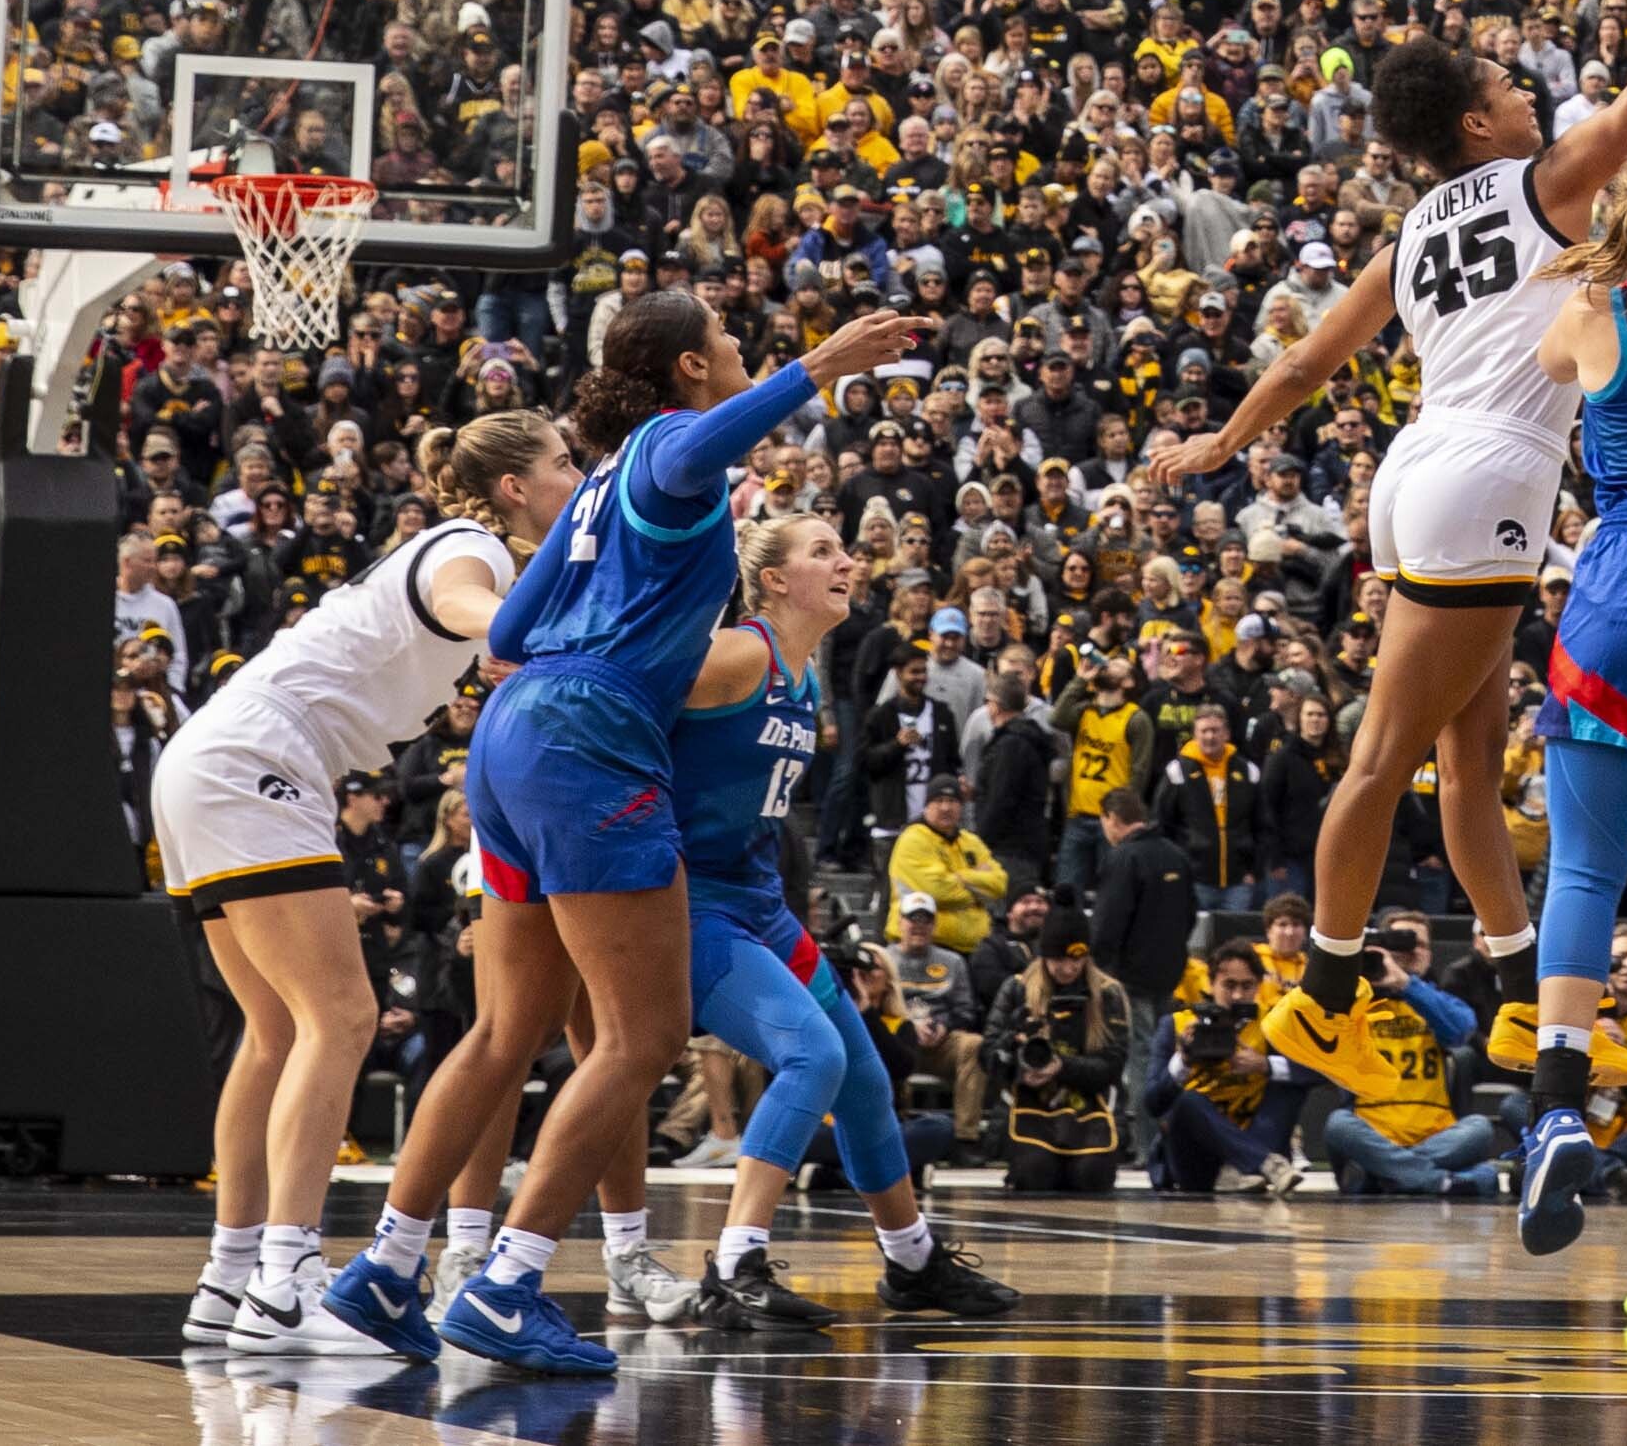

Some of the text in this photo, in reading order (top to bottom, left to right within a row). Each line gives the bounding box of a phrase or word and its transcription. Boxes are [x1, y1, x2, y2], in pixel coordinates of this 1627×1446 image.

[1412, 209, 1519, 317] 45
[759, 757, 804, 818] 13
[1079, 751, 1111, 782] 22
